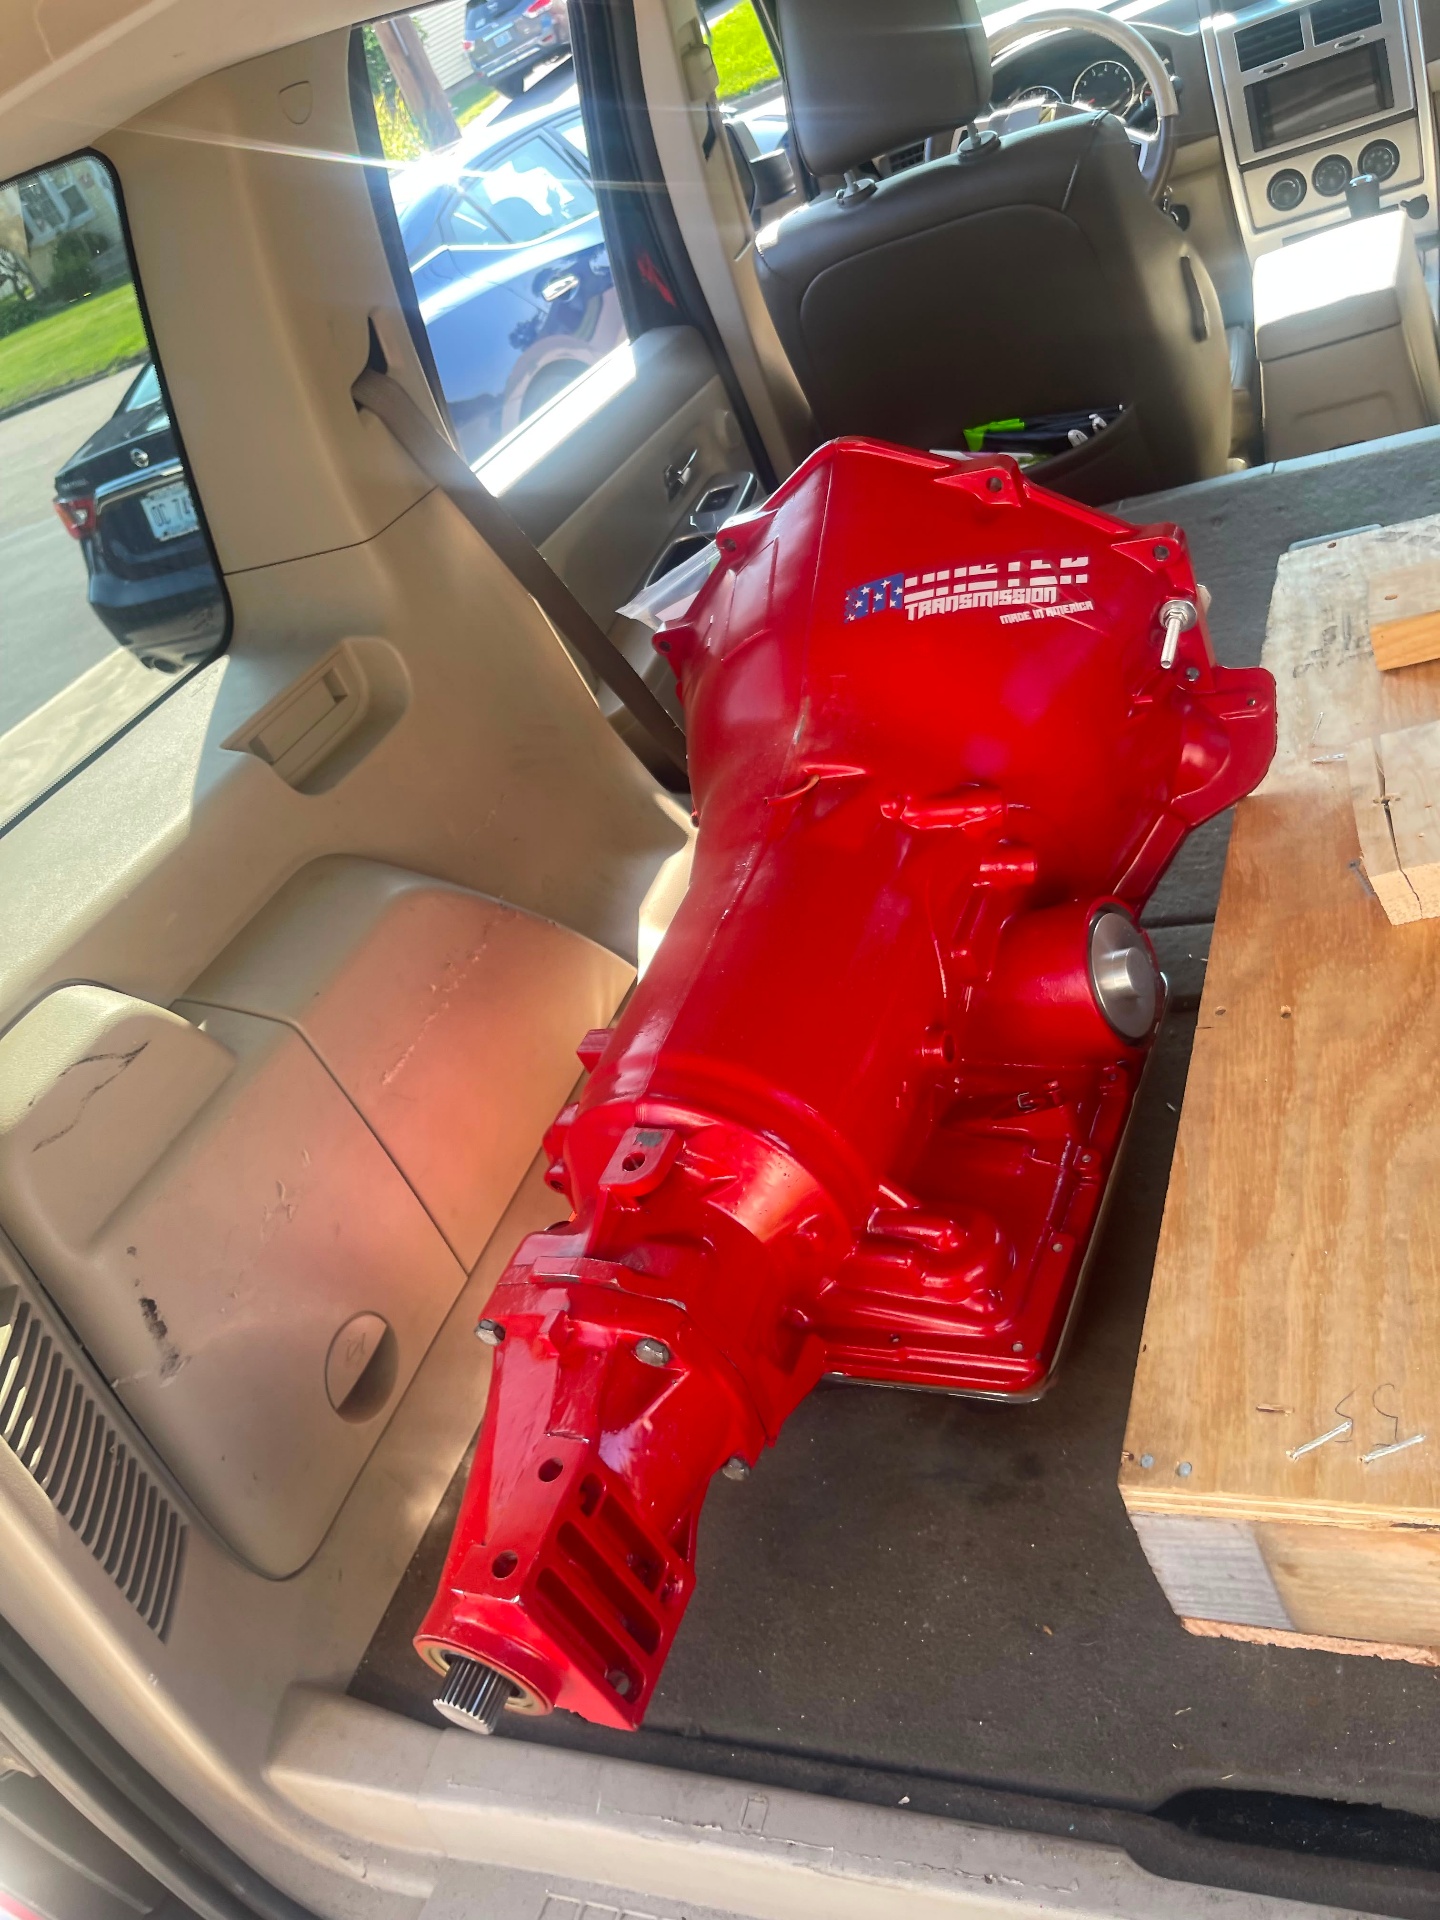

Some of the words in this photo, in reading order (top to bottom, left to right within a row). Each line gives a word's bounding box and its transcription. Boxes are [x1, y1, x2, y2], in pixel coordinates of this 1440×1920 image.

[904, 586, 1057, 622] TRANSMISSION
[999, 611, 1032, 625] MADE
[1032, 608, 1045, 619] IN
[1045, 600, 1094, 617] AMERICA
